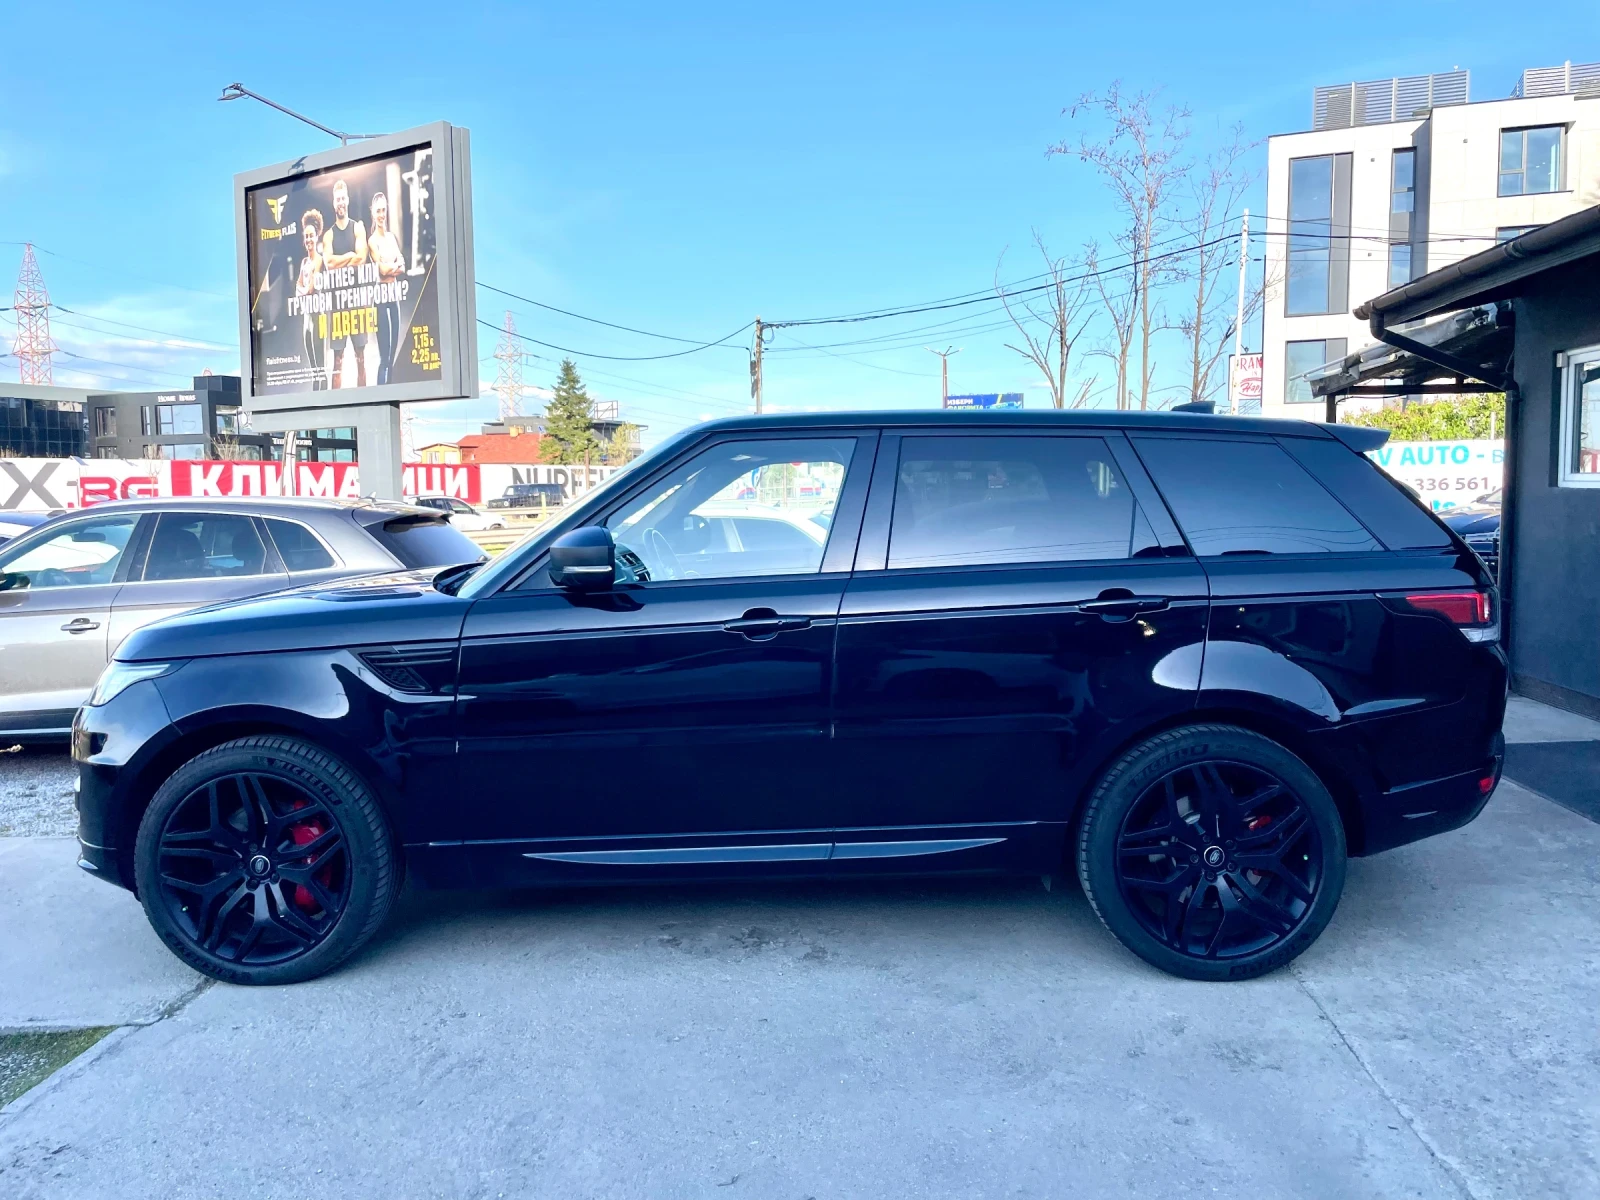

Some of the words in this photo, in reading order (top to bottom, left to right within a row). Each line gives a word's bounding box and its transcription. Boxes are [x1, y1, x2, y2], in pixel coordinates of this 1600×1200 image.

[313, 266, 355, 291] ФИТНЕС
[357, 262, 380, 285] ИЛИ
[287, 291, 333, 317] ГРУПОВИ
[335, 279, 409, 310] ТРЕНИРОВКИ?
[318, 313, 328, 339] И
[332, 307, 378, 341] ДВЕТЕ!
[413, 333, 429, 350] 1,15
[411, 348, 430, 365] 2,25
[1400, 445, 1470, 466] AUTO
[190, 463, 468, 499] КЛИМАИЦИ
